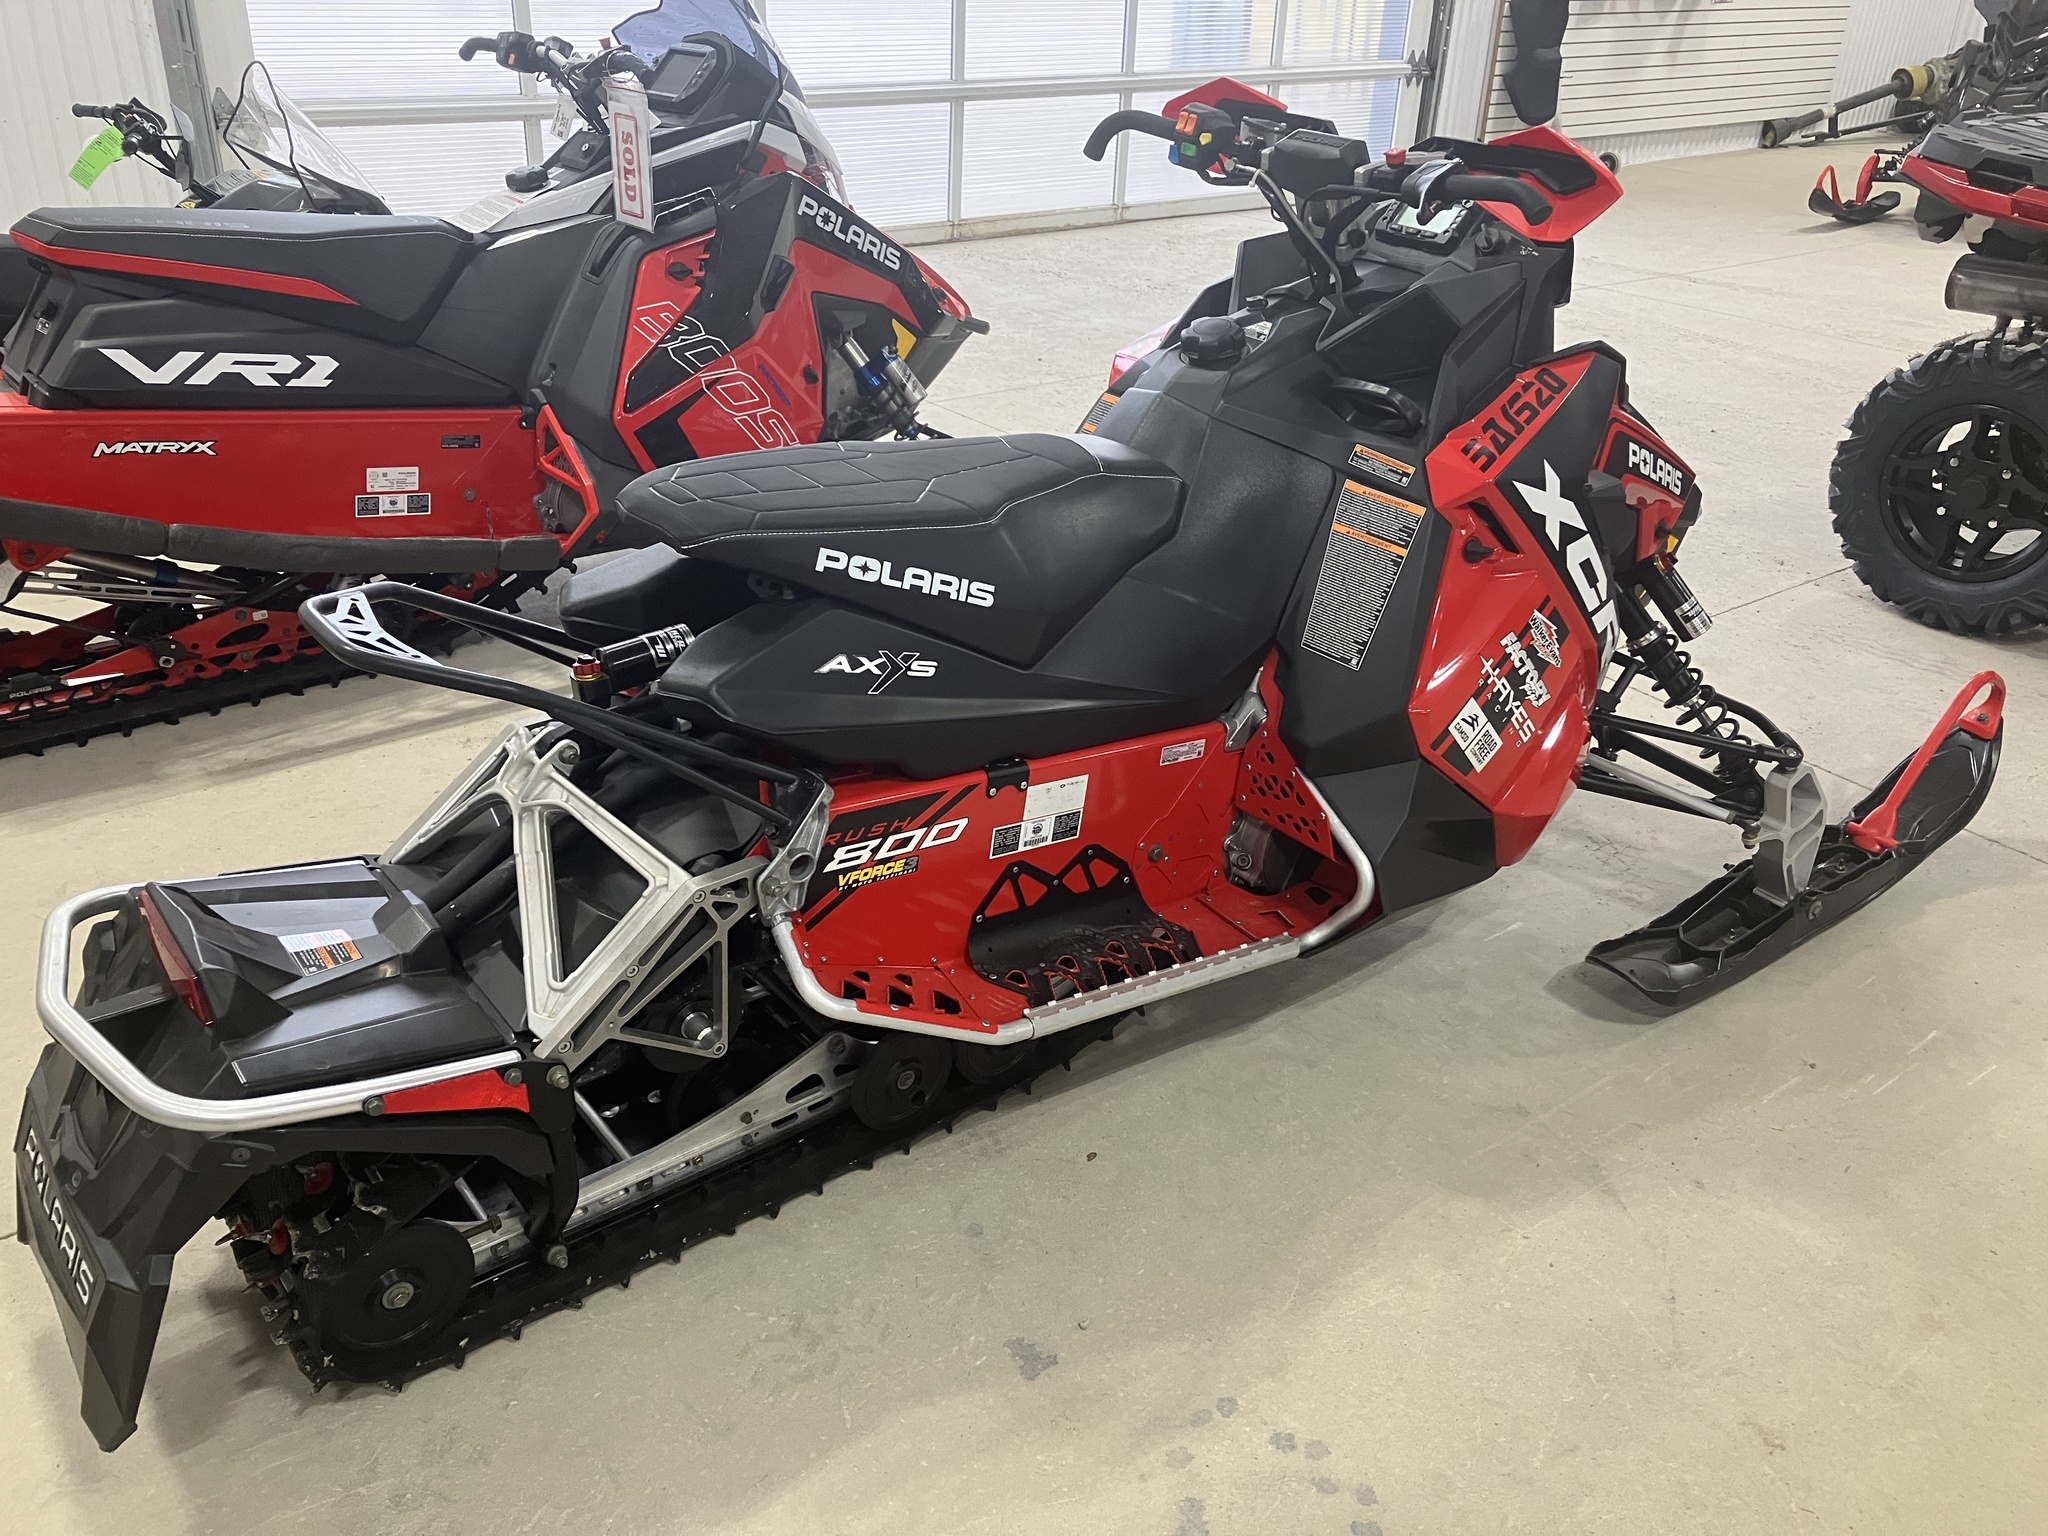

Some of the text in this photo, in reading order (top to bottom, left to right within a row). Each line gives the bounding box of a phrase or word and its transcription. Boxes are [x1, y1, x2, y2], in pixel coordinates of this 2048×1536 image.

[621, 130, 637, 203] SOLD
[797, 194, 901, 271] POLARIS
[97, 348, 341, 388] VR1
[633, 301, 800, 450] BOOS
[93, 441, 217, 457] MATRYX
[1629, 441, 1683, 496] POLARIS
[1366, 490, 1410, 509] AVERTISSEMENT
[1350, 530, 1393, 550] AVERTISSEMENT
[815, 547, 996, 608] POLARIS
[1530, 614, 1561, 667] Walker Evans
[9, 686, 52, 699] POLARIS
[813, 650, 939, 695] AXYS
[1500, 631, 1552, 707] FACTORY
[1478, 678, 1521, 748] RACING
[1479, 654, 1536, 743] HAYES
[1454, 722, 1470, 743] CAMSO
[1474, 738, 1491, 761] FREE
[1481, 730, 1498, 752] ROAD
[822, 817, 970, 873] 800
[823, 816, 912, 846] RUSH
[838, 856, 919, 887] VFORCE3
[25, 1127, 94, 1306] POLARIS
